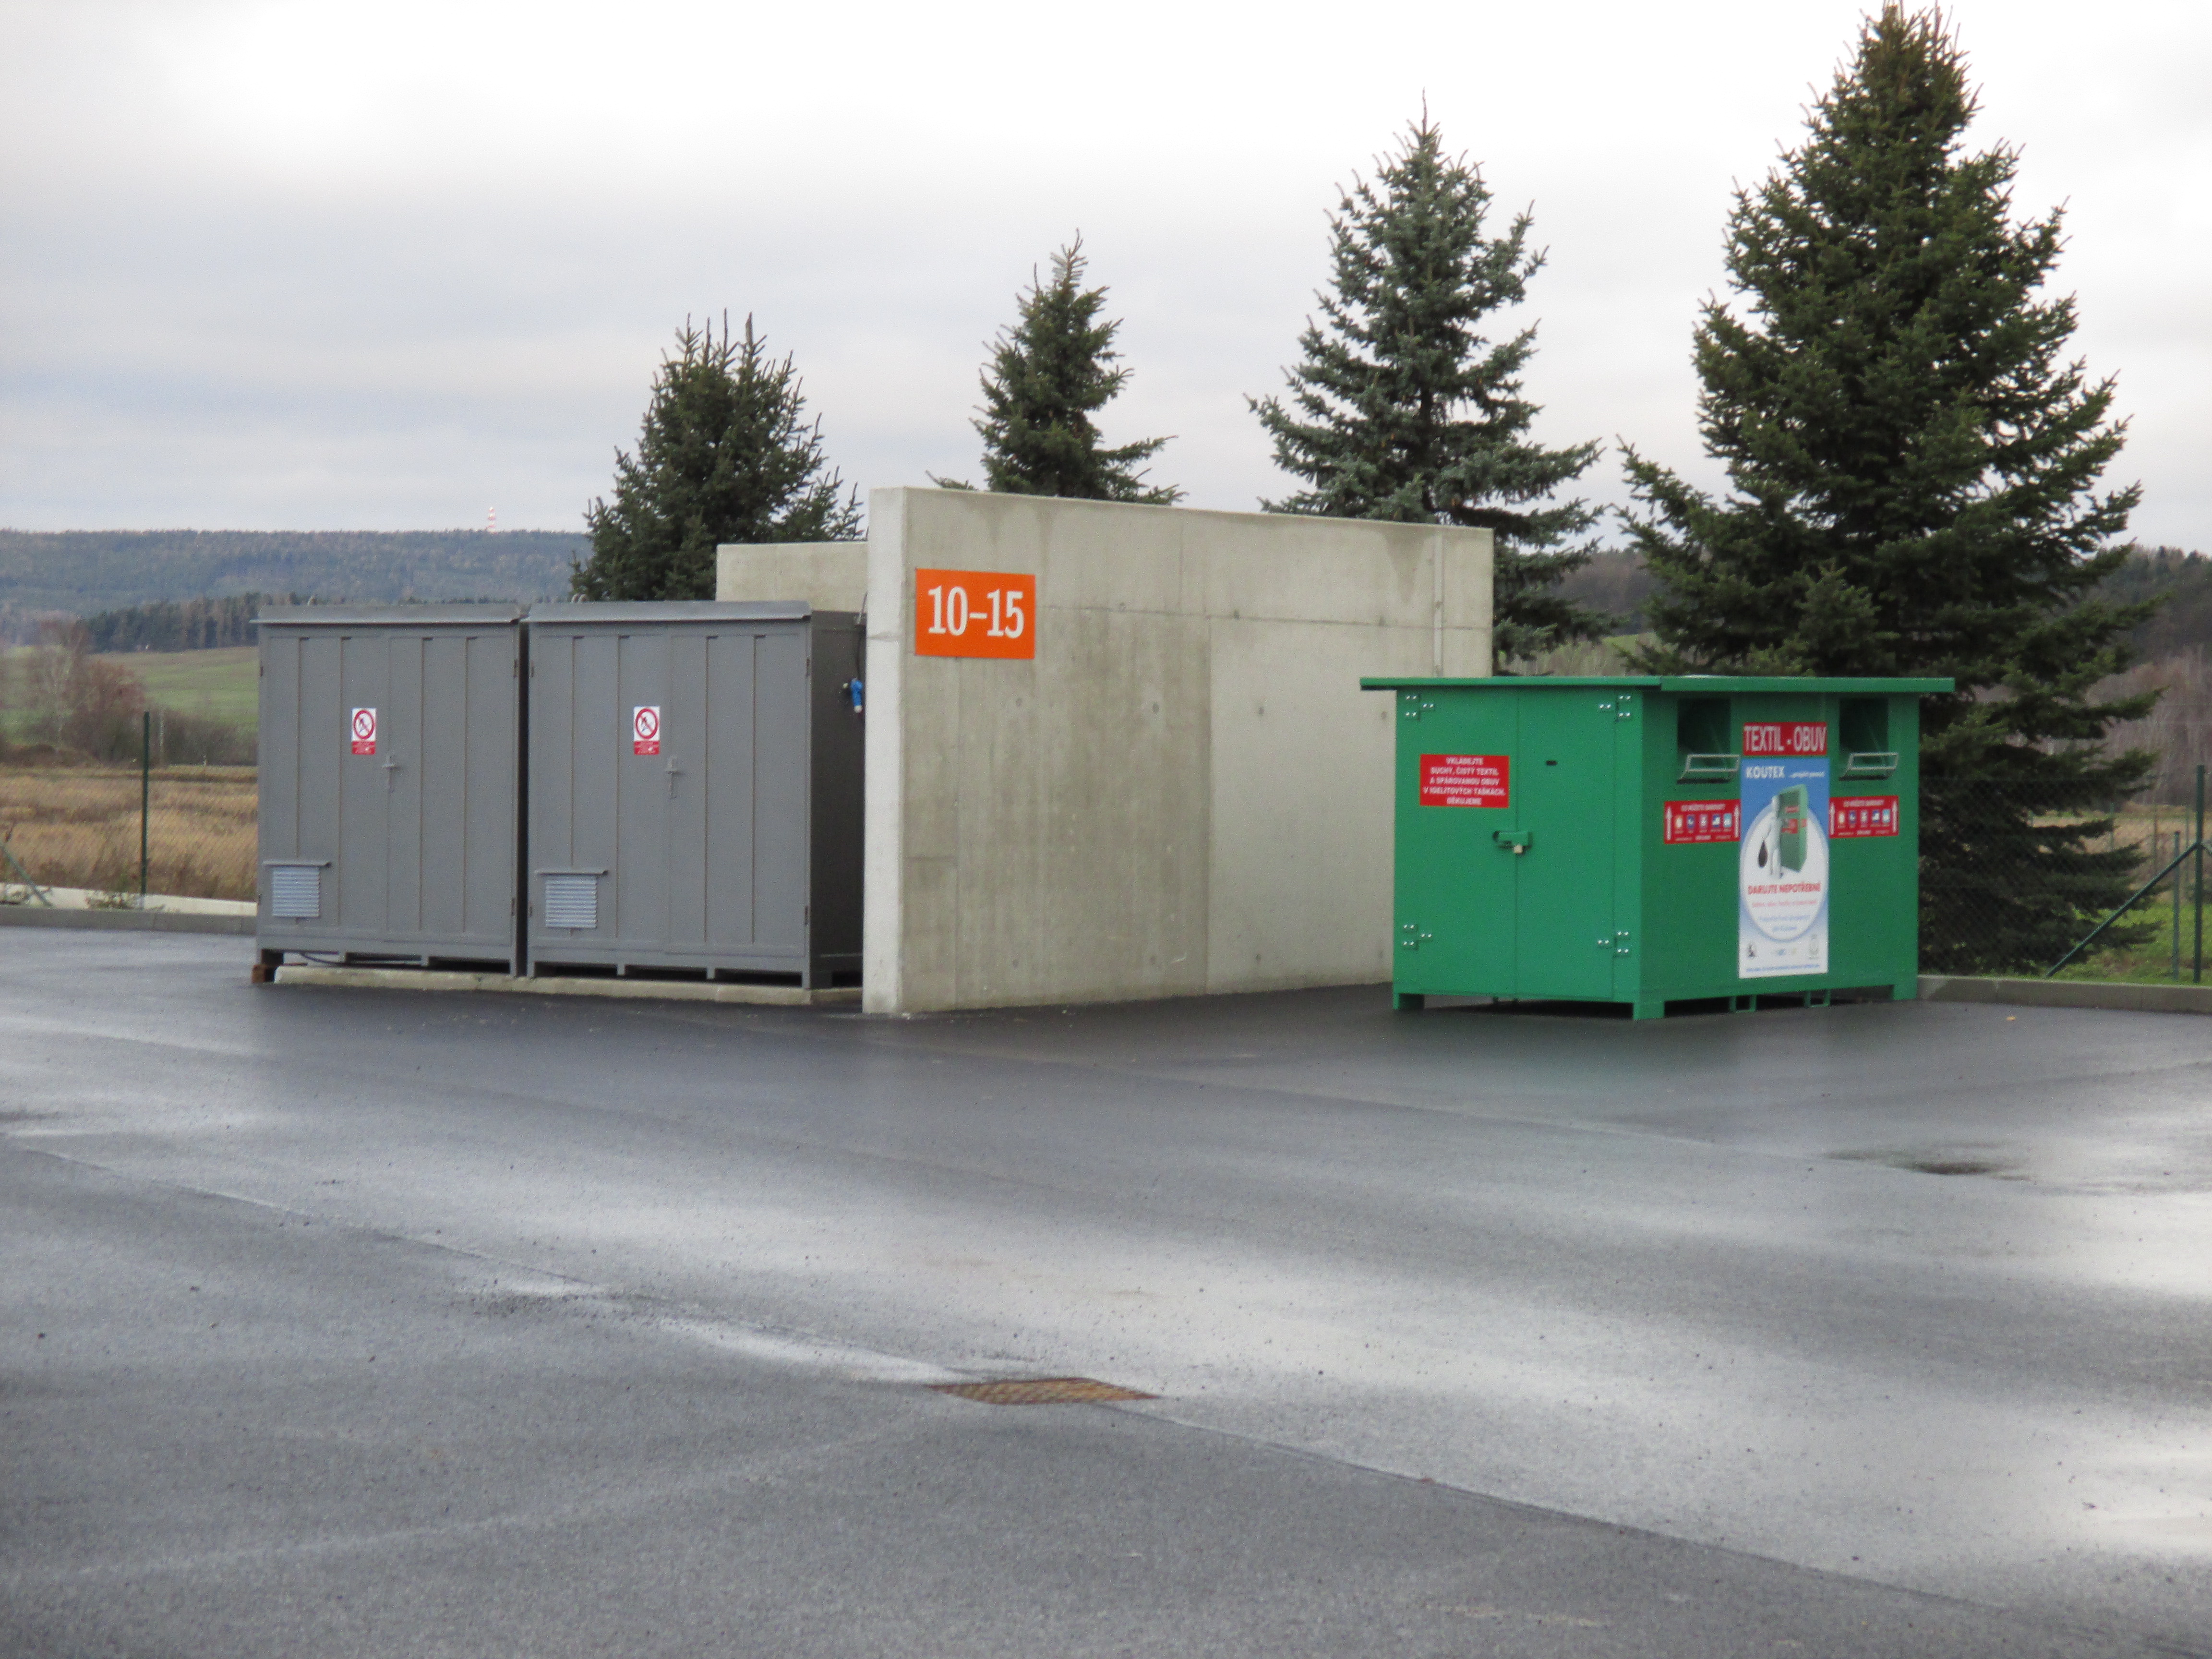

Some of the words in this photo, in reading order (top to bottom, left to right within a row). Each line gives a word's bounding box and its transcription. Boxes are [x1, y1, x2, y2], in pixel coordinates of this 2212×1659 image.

[928, 585, 1024, 639] 10-15
[1744, 726, 1785, 752] TEXTIL
[1793, 725, 1827, 752] OBUV
[1746, 766, 1785, 779] KOUTEX
